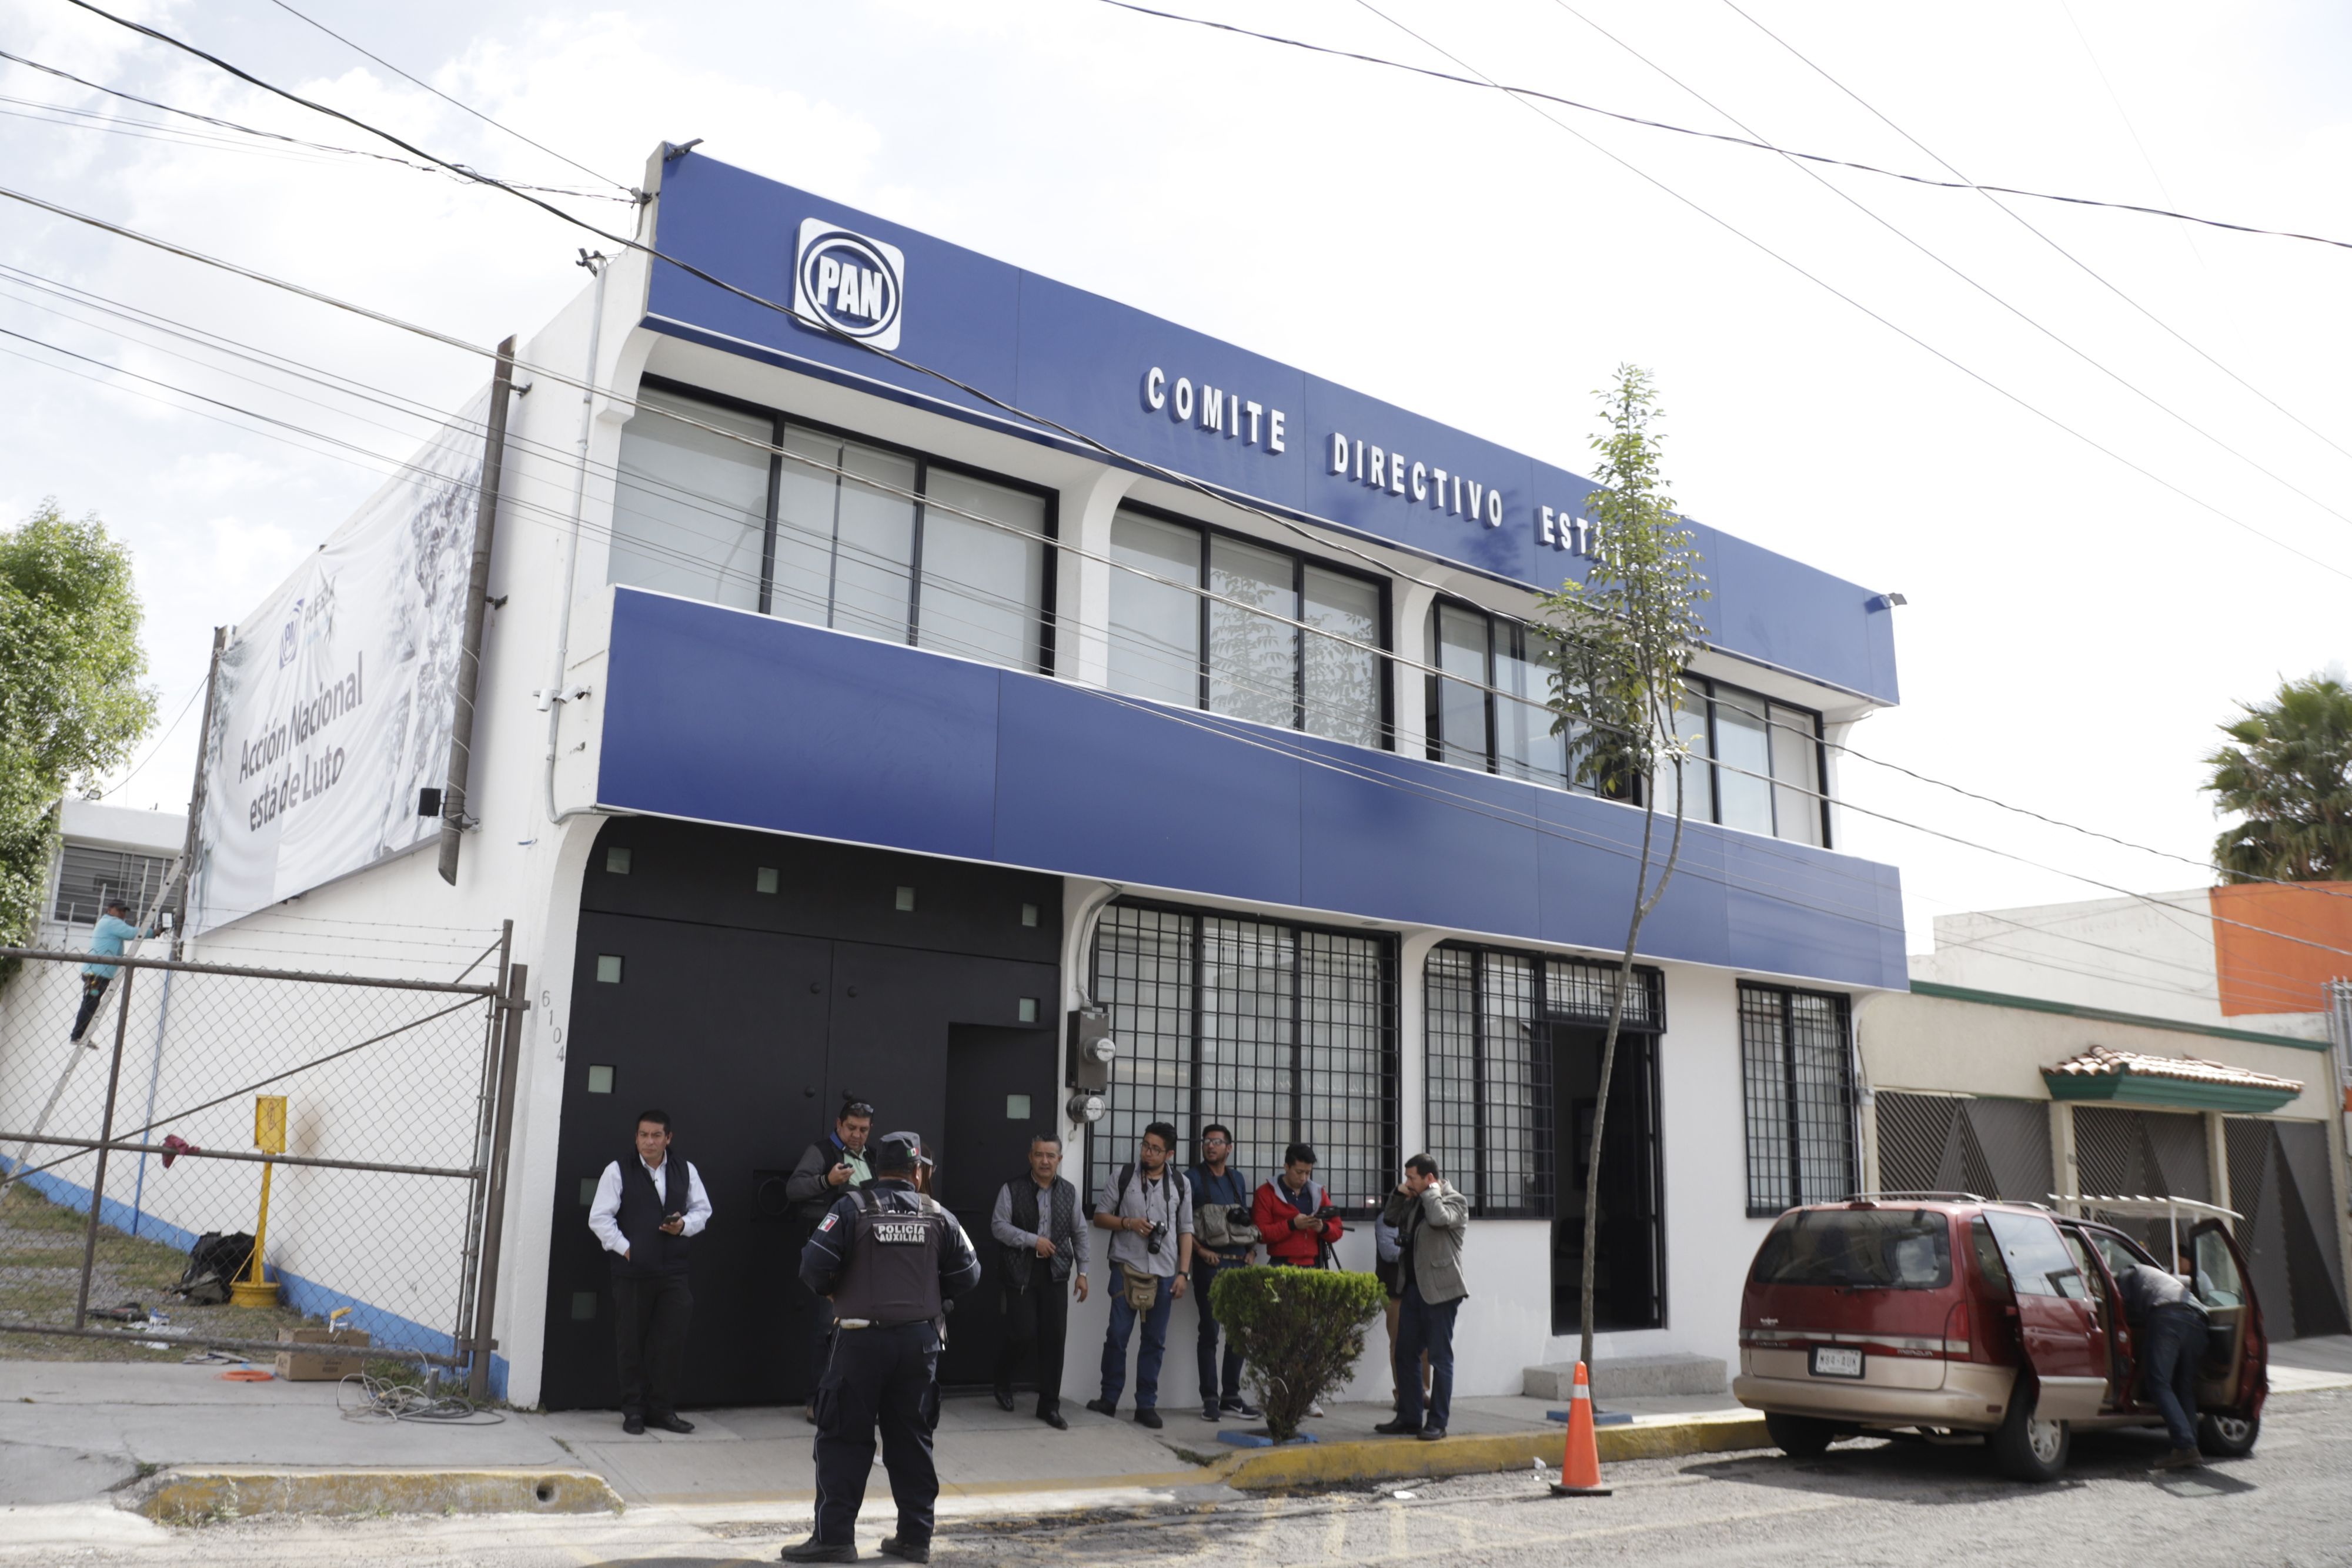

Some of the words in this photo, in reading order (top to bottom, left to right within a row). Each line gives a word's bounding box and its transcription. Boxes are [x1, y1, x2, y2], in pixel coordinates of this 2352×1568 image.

[817, 255, 883, 321] PAN
[1147, 366, 1285, 453] COMITE
[1333, 432, 1502, 529] DIRECTIVO
[239, 717, 287, 784] Acción
[288, 650, 363, 752] Nacional
[249, 773, 278, 833] está
[279, 763, 299, 815] de
[302, 744, 346, 803] Luto
[542, 989, 565, 1062] 6104
[880, 1233, 925, 1243] AUXILIAR
